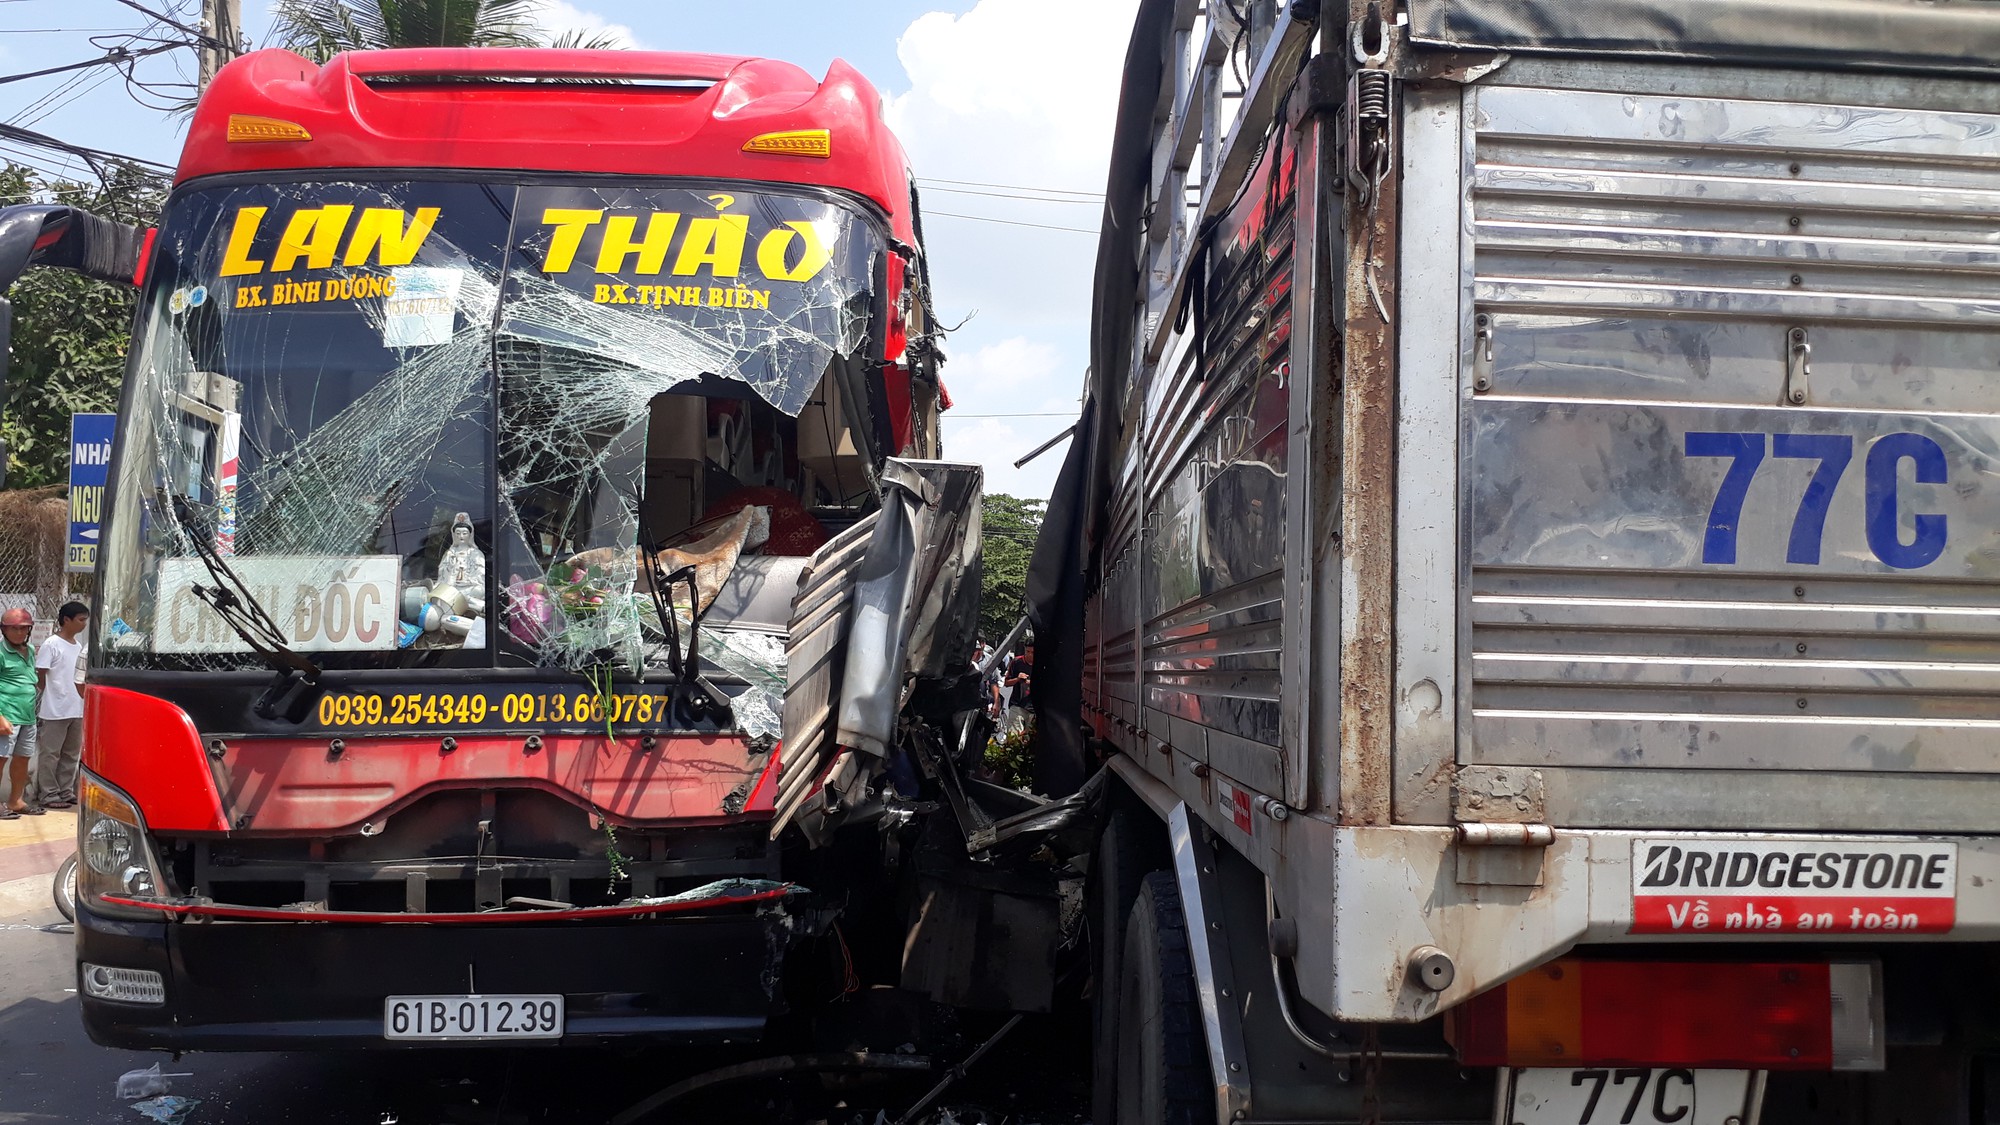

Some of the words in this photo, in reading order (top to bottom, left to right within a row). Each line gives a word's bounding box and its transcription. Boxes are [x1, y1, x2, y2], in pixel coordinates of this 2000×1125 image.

[219, 204, 441, 277] LAN
[541, 194, 836, 283] THẢO
[235, 285, 267, 309] BX.
[272, 277, 322, 305] BÌNH
[324, 273, 397, 301] DƯƠNG
[708, 283, 771, 310] BIÊN
[72, 485, 105, 524] NGU
[1684, 431, 1948, 570] 77C
[293, 566, 382, 644] ĐỐC
[1640, 845, 1949, 889] BRIDGESTONE
[1666, 899, 1710, 930] Về
[1725, 902, 1783, 930] nhà
[1798, 911, 1833, 930] an
[1849, 906, 1919, 930] toàn
[392, 1001, 556, 1034] 61B-012.39
[1571, 1069, 1694, 1125] 77C
